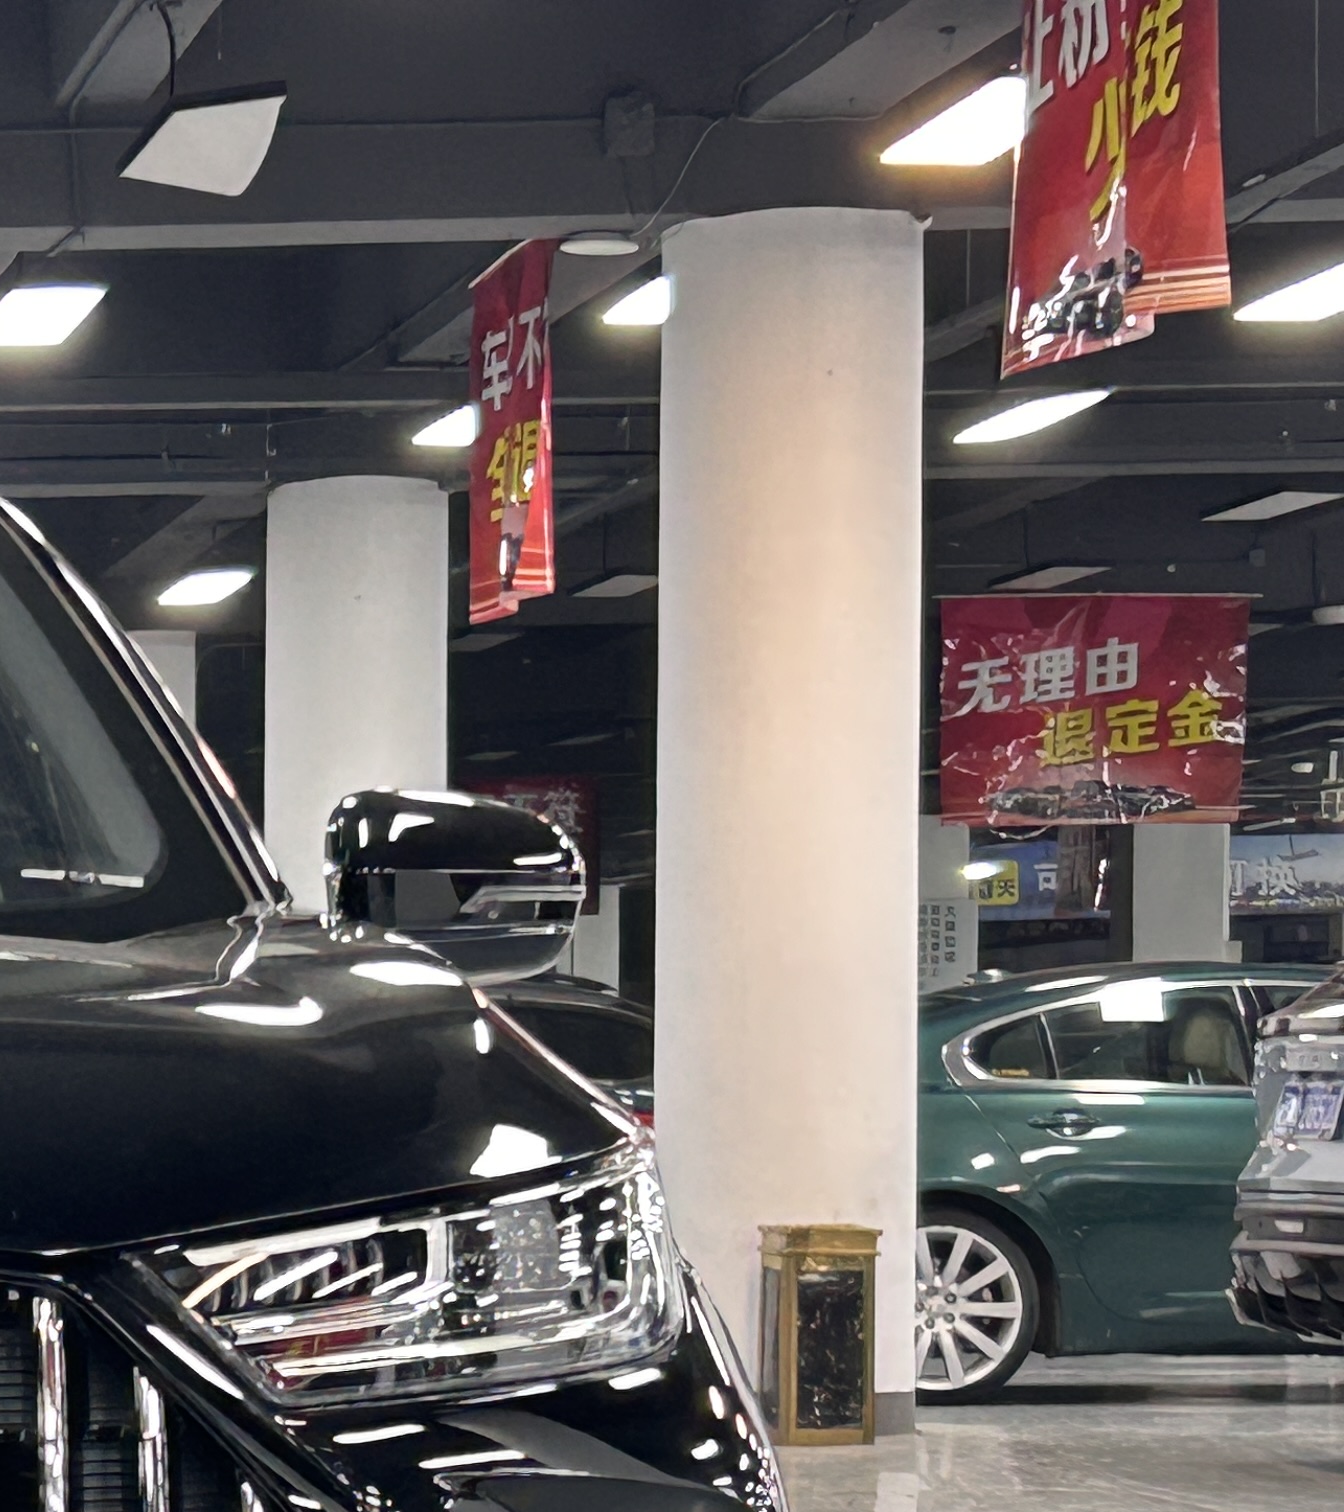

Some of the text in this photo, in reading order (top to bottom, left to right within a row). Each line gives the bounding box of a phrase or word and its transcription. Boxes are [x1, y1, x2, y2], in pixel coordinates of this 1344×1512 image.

[955, 638, 1140, 716] 无理由
[1039, 688, 1223, 768] 退定金
